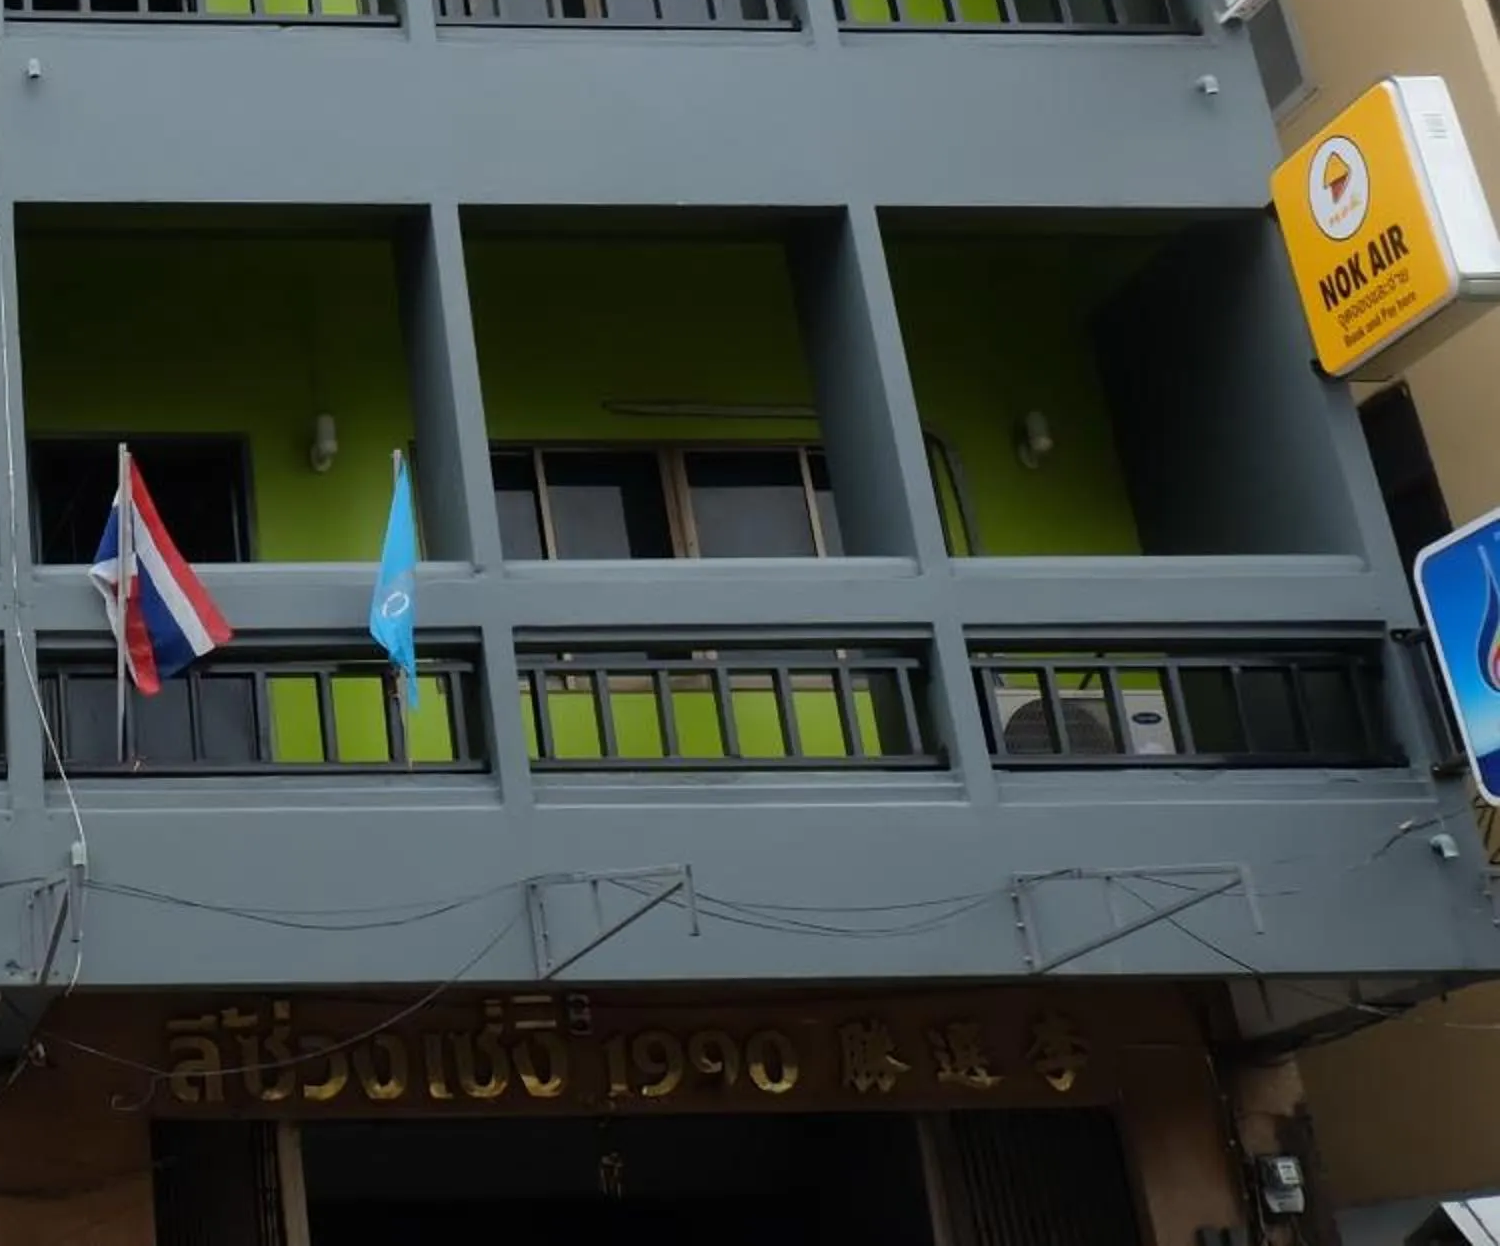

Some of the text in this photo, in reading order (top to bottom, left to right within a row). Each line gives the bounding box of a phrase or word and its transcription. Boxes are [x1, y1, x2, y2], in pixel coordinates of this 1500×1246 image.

[1318, 223, 1410, 312] NOK AIR
[601, 1025, 802, 1099] 1990
